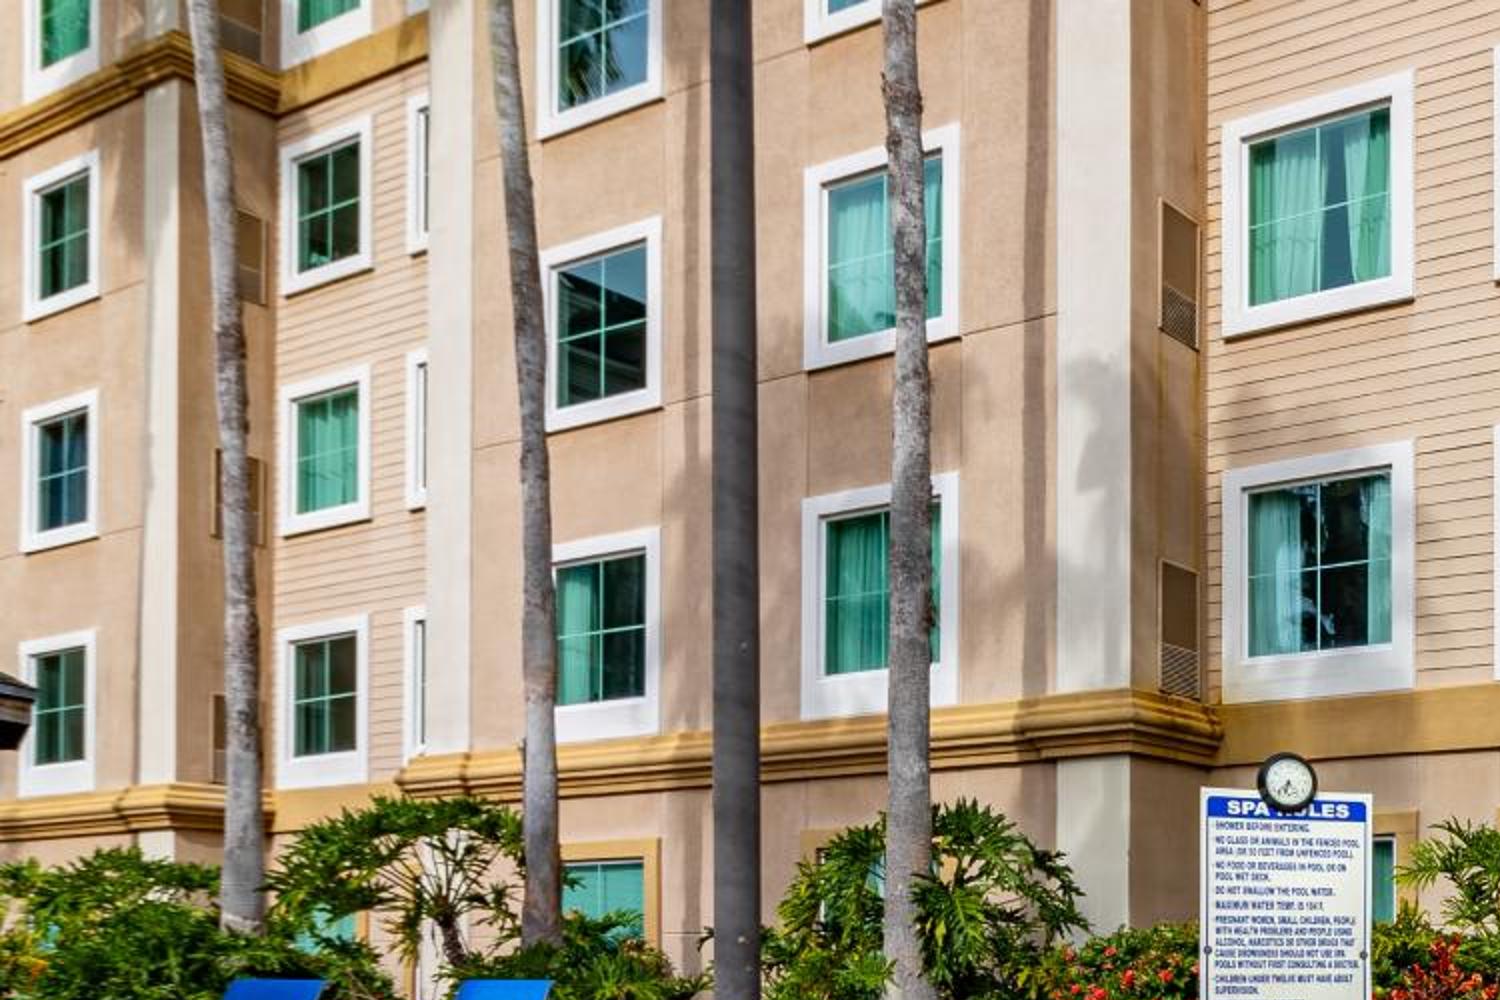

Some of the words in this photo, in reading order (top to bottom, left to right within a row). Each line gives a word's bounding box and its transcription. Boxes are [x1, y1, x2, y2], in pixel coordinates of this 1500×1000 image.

[1227, 800, 1270, 816] SPA
[1277, 803, 1350, 818] LES
[1216, 835, 1225, 844] NO
[1216, 860, 1224, 869] NO
